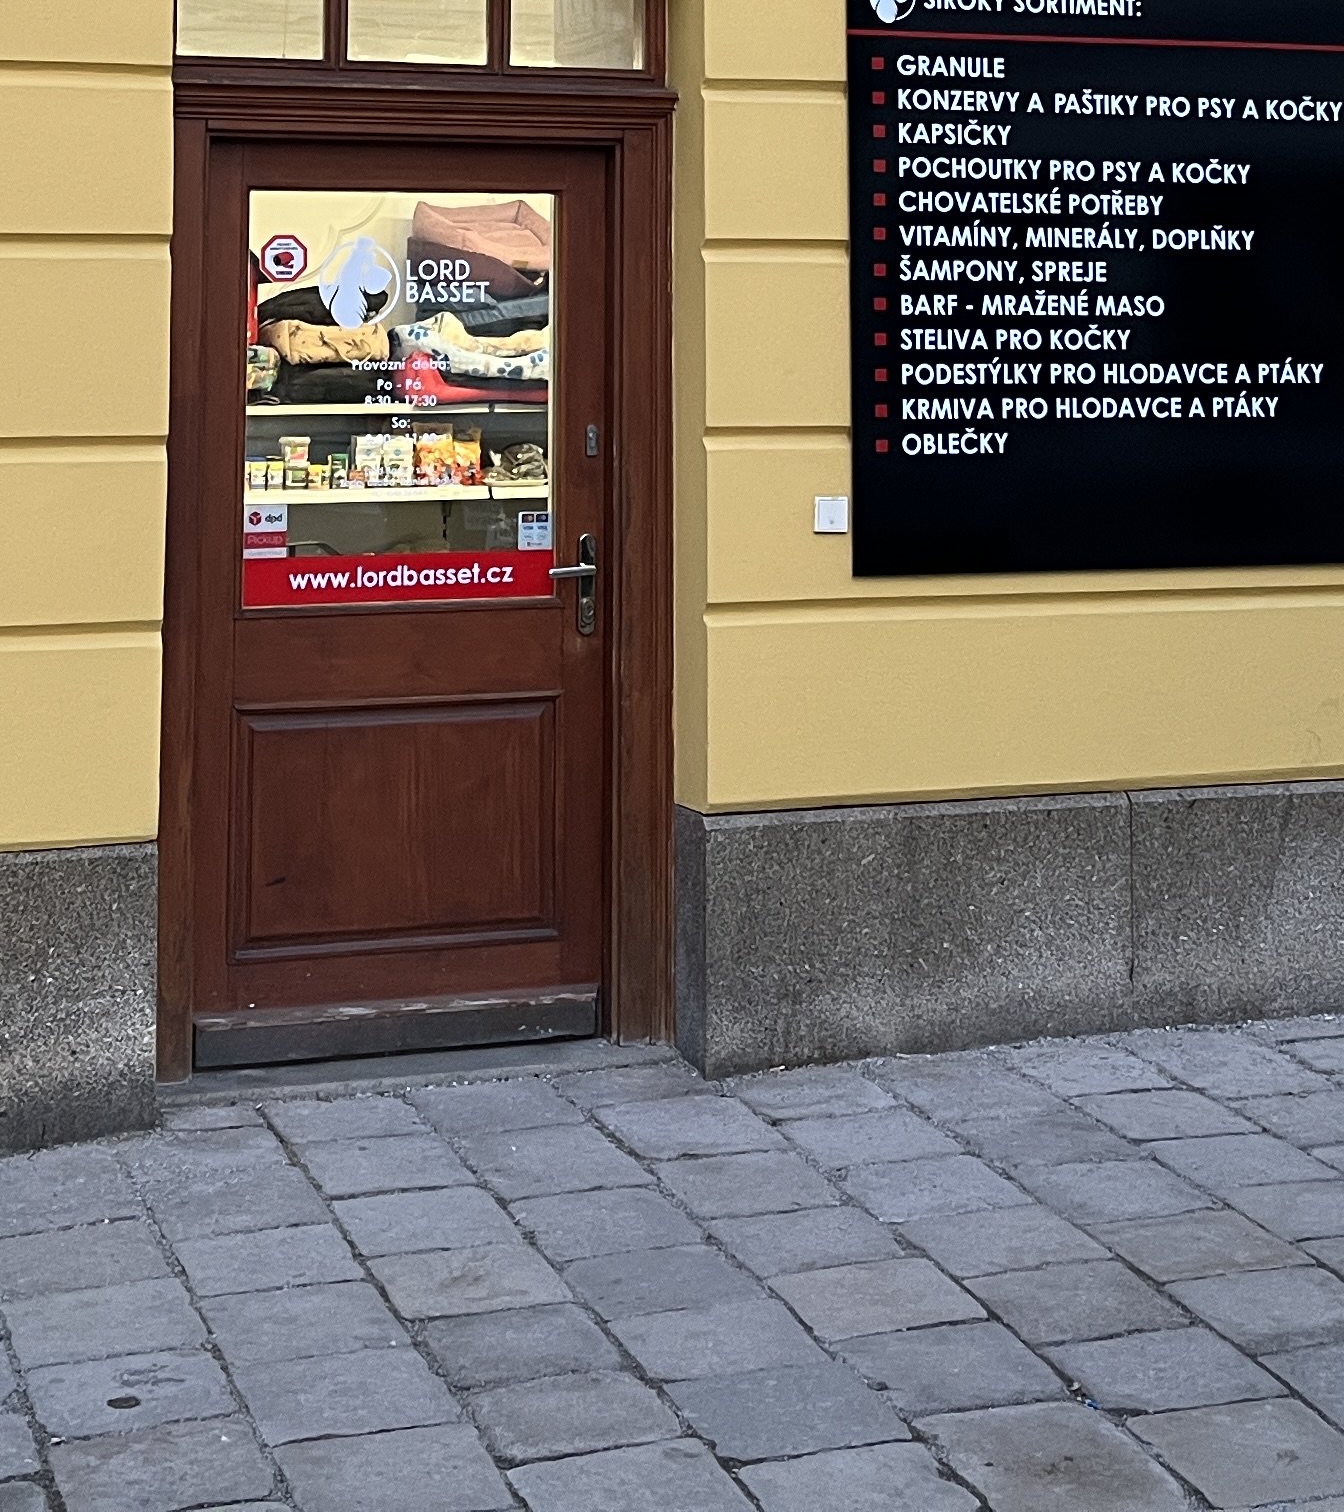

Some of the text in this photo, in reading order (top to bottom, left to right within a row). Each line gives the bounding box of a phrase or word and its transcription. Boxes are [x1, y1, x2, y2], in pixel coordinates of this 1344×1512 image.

[897, 54, 1005, 78] GRANULE
[898, 89, 1343, 122] KONZERVY A PAŠTIKY PRO PSY A KOČKY
[898, 118, 1012, 146] KAPSIČKY
[898, 157, 1251, 184] POCHOUTKY PRO PSY A KOČKY
[898, 187, 1164, 216] CHOVATELSKÉ POTŘEBY
[899, 221, 1255, 252] VITAMÍNY, MINERÁLY, DOPLŇKY
[406, 260, 471, 281] LORD
[899, 254, 1108, 283] ŠAMPONY, SPREJE
[406, 281, 490, 303] BASSET
[900, 295, 957, 316] BARF
[981, 290, 1089, 316] MRAŽENÉ
[1095, 296, 1165, 317] MASO
[900, 323, 1131, 350] STELIVA PRO KOČKY
[352, 358, 405, 370] Provozní
[901, 357, 1324, 385] PODESTÝLKY PRO HLODAVCE A PTÁKY
[377, 379, 392, 390] Po
[365, 395, 391, 405] 8:30
[405, 395, 436, 406] 17:30
[901, 390, 1279, 420] KRMIVA PRO HLODAVCE A PTÁKY
[392, 417, 411, 428] So:
[902, 427, 1009, 455] OBLEČKY
[289, 563, 513, 590] www.lordbasset.cz
